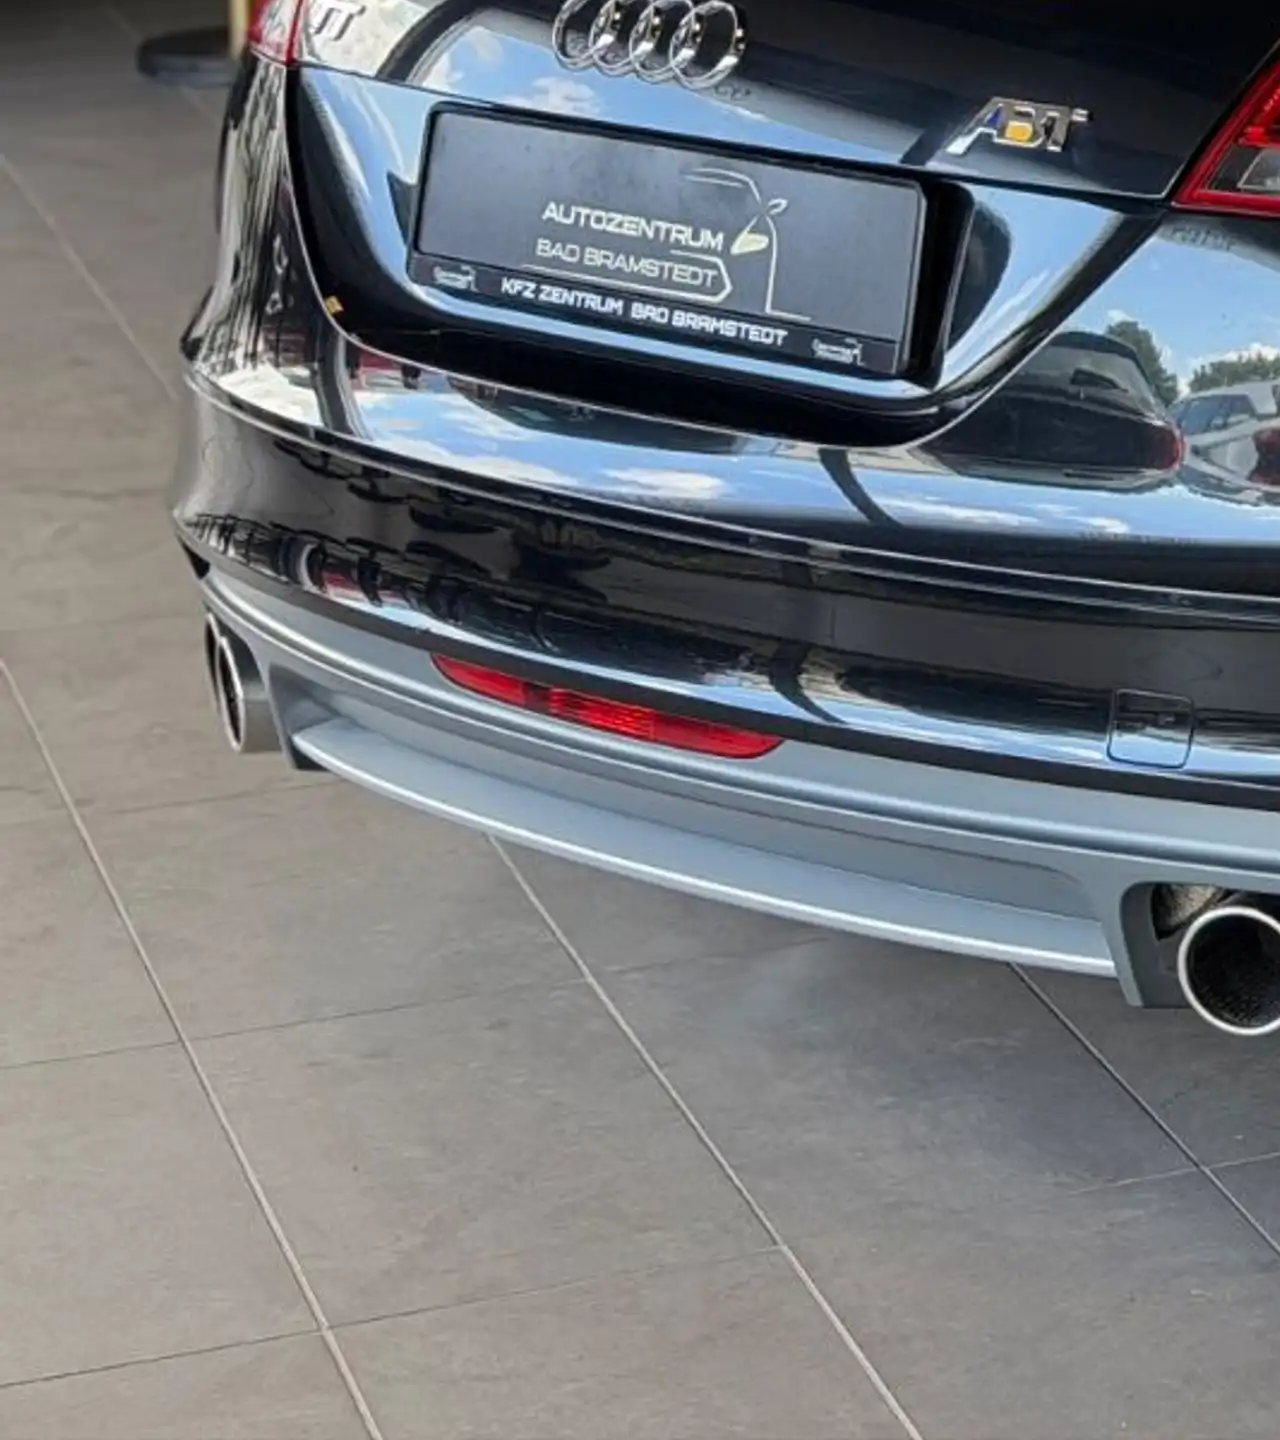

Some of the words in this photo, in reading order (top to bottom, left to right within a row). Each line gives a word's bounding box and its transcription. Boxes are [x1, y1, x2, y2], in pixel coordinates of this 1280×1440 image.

[541, 200, 725, 252] AUTOZENTRUM
[535, 237, 580, 264] BAD
[582, 246, 719, 289] BRAMSTEDT
[500, 276, 537, 299] KFZ
[538, 283, 625, 316] ZENTRUM
[630, 301, 669, 326] BAD
[671, 309, 789, 348] BRAMSTEDT
